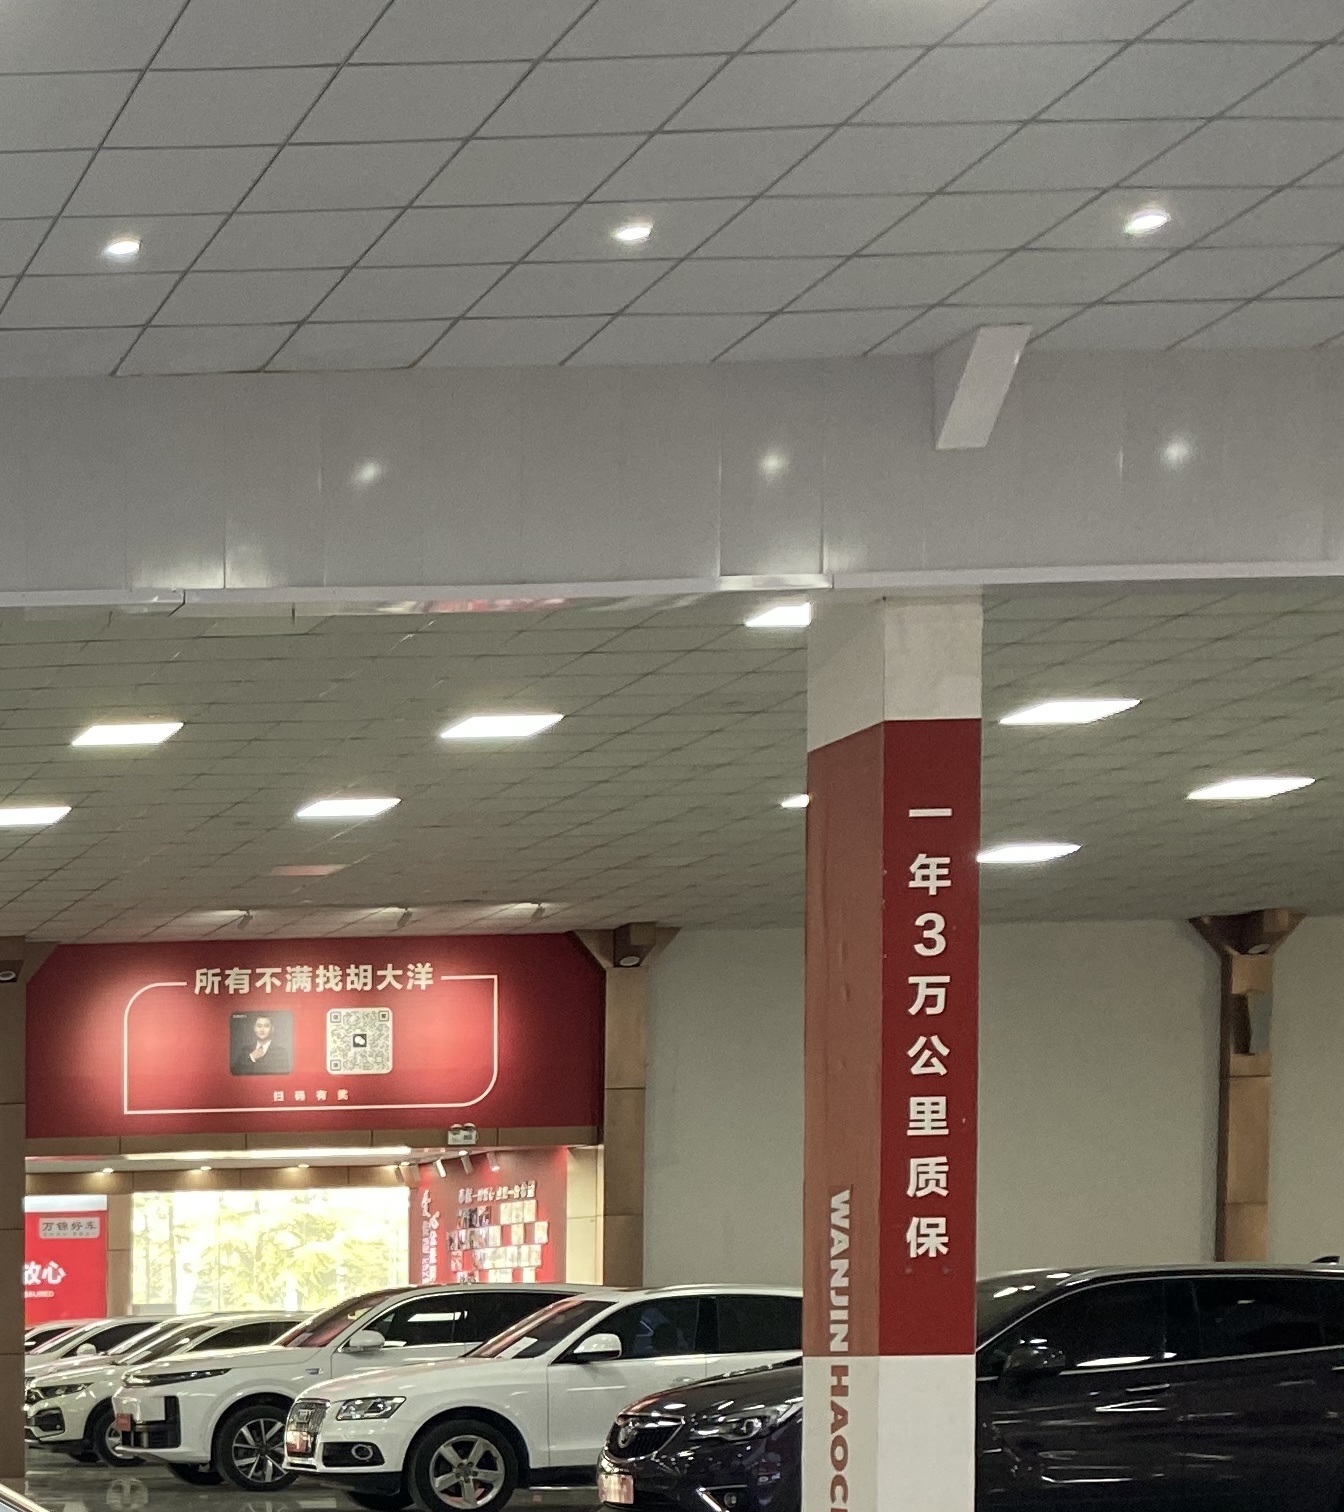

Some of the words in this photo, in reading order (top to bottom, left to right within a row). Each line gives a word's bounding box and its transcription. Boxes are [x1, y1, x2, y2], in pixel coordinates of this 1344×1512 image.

[193, 963, 434, 996] 所有不满找胡大洋
[905, 807, 954, 1259] 一年3万公里质保
[826, 1188, 852, 1353] WANJIN
